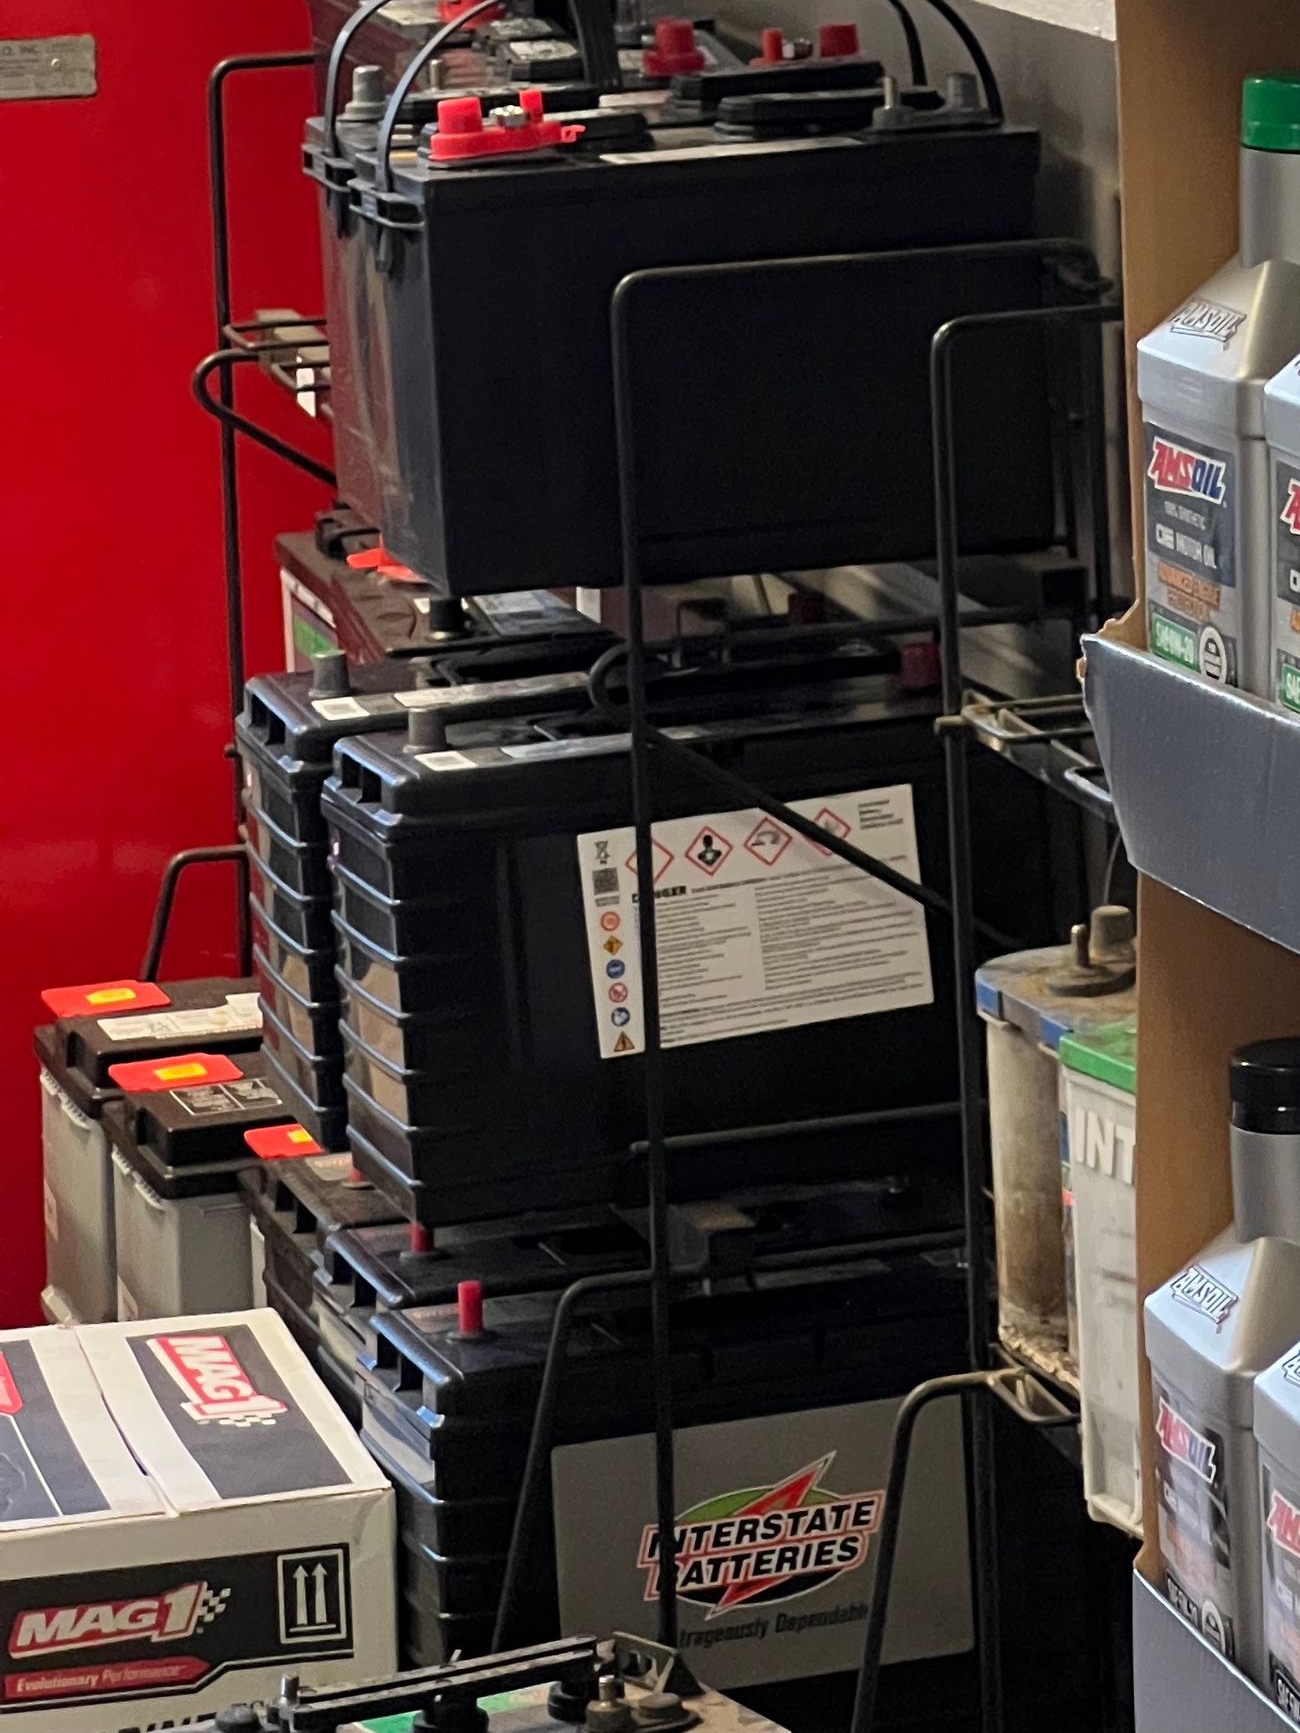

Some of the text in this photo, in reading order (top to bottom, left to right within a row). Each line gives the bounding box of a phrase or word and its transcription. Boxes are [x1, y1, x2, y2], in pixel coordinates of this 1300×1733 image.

[1168, 299, 1247, 342] AMSOIL
[1148, 436, 1226, 505] AMSOIL
[1176, 532, 1203, 563] MOTOR
[1203, 544, 1217, 569] OIL
[632, 885, 687, 903] DNGER
[1076, 1107, 1136, 1185] INT
[1170, 1266, 1238, 1324] AMSOIL
[1156, 1397, 1216, 1484] AMSOIL
[657, 1536, 859, 1592] ATTERIES
[17, 1663, 188, 1694] Evolutionary Performance
